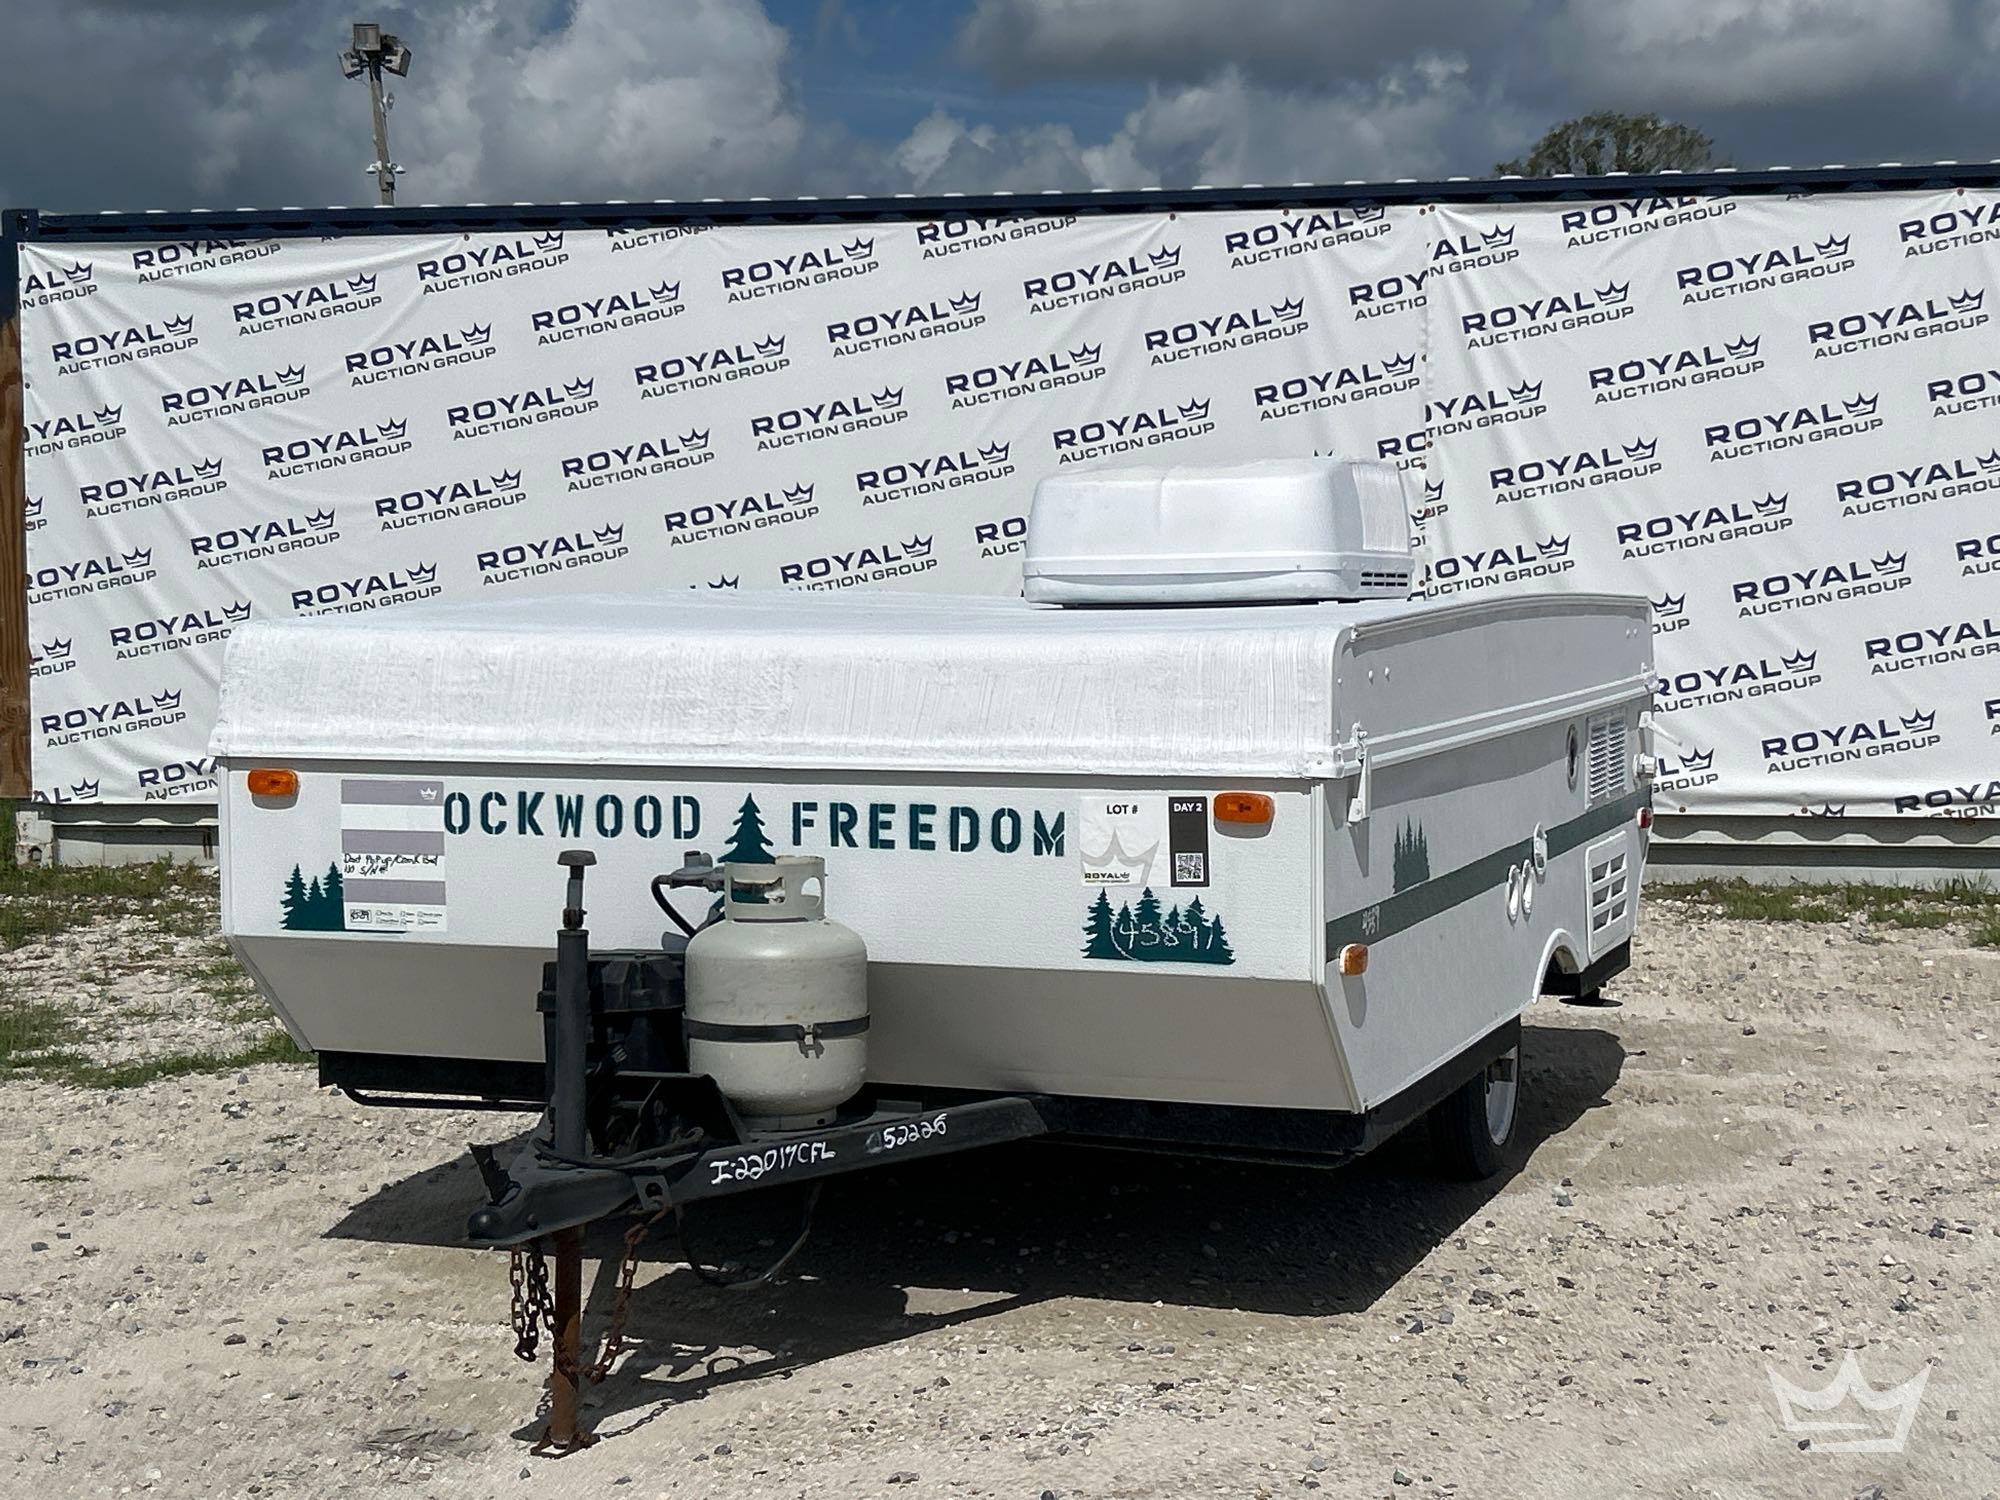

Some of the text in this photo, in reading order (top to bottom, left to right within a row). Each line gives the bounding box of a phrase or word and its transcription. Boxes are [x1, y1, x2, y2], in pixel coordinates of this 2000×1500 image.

[923, 215, 1078, 260] AUCTION GROUP
[1224, 209, 1355, 254] ROYAL
[1230, 223, 1392, 269] AUCTION GROUP
[1568, 202, 1736, 248] AUCTION GROUP
[1904, 228, 2000, 259] AUCTION
[139, 242, 282, 284] AUCTION GROUP
[416, 240, 536, 282] ROYAL
[422, 253, 569, 296] AUCTION GROUP
[721, 247, 844, 289] ROYAL
[727, 260, 880, 304] AUCTION GROUP
[1023, 256, 1150, 300] ROYAL
[1449, 250, 1519, 272] GROUP
[1676, 245, 1815, 290] ROYAL
[38, 285, 97, 305] GROUP
[232, 282, 349, 323] ROYAL
[1029, 269, 1186, 315] AUCTION GROUP
[1682, 259, 1856, 306] AUCTION GROUP
[238, 295, 383, 337] AUCTION GROUP
[531, 290, 651, 332] ROYAL
[537, 303, 686, 347] AUCTION GROUP
[826, 301, 951, 344] ROYAL
[1144, 308, 1273, 352] ROYAL
[1461, 291, 1596, 335] ROYAL
[1467, 305, 1635, 351] AUCTION GROUP
[1807, 299, 1950, 344] ROYAL
[51, 323, 166, 363] ROYAL
[57, 337, 199, 377] AUCTION GROUP
[344, 333, 463, 374] ROYAL
[833, 315, 986, 358] AUCTION GROUP
[1150, 321, 1309, 367] AUCTION GROUP
[1814, 313, 1990, 360] AUCTION GROUP
[351, 346, 497, 388] AUCTION GROUP
[634, 344, 756, 386] ROYAL
[640, 358, 790, 400] AUCTION GROUP
[945, 353, 1071, 396] ROYAL
[1253, 363, 1383, 407] ROYAL
[1588, 345, 1726, 390] ROYAL
[1594, 360, 1765, 405] AUCTION GROUP
[161, 374, 278, 413] ROYAL
[167, 387, 311, 428] AUCTION GROUP
[446, 386, 566, 427] ROYAL
[951, 366, 1106, 410] AUCTION GROUP
[1260, 377, 1421, 422] AUCTION GROUP
[453, 400, 599, 441] AUCTION GROUP
[750, 396, 874, 438] ROYAL
[757, 410, 909, 452] AUCTION GROUP
[1052, 408, 1179, 451] ROYAL
[1477, 405, 1546, 427] GROUP
[1704, 403, 1844, 448] ROYAL
[68, 427, 126, 448] GROUP
[261, 427, 379, 467] ROYAL
[561, 438, 681, 478] ROYAL
[1058, 421, 1215, 465] AUCTION GROUP
[1710, 417, 1884, 463] AUCTION GROUP
[267, 441, 413, 481] AUCTION GROUP
[567, 451, 715, 493] AUCTION GROUP
[856, 451, 980, 492] ROYAL
[1489, 447, 1624, 490] ROYAL
[1837, 460, 1977, 502] ROYAL
[79, 467, 195, 505] ROYAL
[86, 480, 228, 519] AUCTION GROUP
[374, 478, 493, 518] ROYAL
[862, 464, 1015, 507] AUCTION GROUP
[1495, 462, 1662, 505] AUCTION GROUP
[1843, 490, 1937, 517] AUCTION
[381, 492, 527, 532] AUCTION GROUP
[663, 492, 785, 533] ROYAL
[670, 506, 820, 547] AUCTION GROUP
[1616, 503, 1754, 545] ROYAL
[189, 517, 308, 556] ROYAL
[197, 531, 341, 570] AUCTION GROUP
[476, 532, 596, 572] ROYAL
[1622, 517, 1793, 561] AUCTION GROUP
[97, 570, 156, 590] GROUP
[483, 546, 629, 586] AUCTION GROUP
[780, 545, 902, 584] ROYAL
[872, 559, 937, 580] GROUP
[1504, 560, 1574, 582] GROUP
[1732, 561, 1872, 604] ROYAL
[292, 572, 408, 609] ROYAL
[379, 586, 441, 606] GROUP
[1738, 576, 1912, 619] AUCTION GROUP
[110, 610, 223, 646] ROYAL
[117, 637, 191, 660] AUCTION
[1864, 618, 2000, 660] ROYAL
[1872, 648, 1966, 675] AUCTION
[1748, 675, 1821, 696] GROUP
[40, 697, 154, 735] ROYAL
[46, 711, 187, 748] AUCTION GROUP
[1761, 719, 1901, 760] ROYAL
[1767, 734, 1941, 775] AUCTION GROUP
[444, 791, 1066, 858] OCKWOOD FREEDOM
[1106, 804, 1129, 815] LOT
[1173, 802, 1203, 813] DAY 2
[1084, 872, 1119, 880] ROYAL
